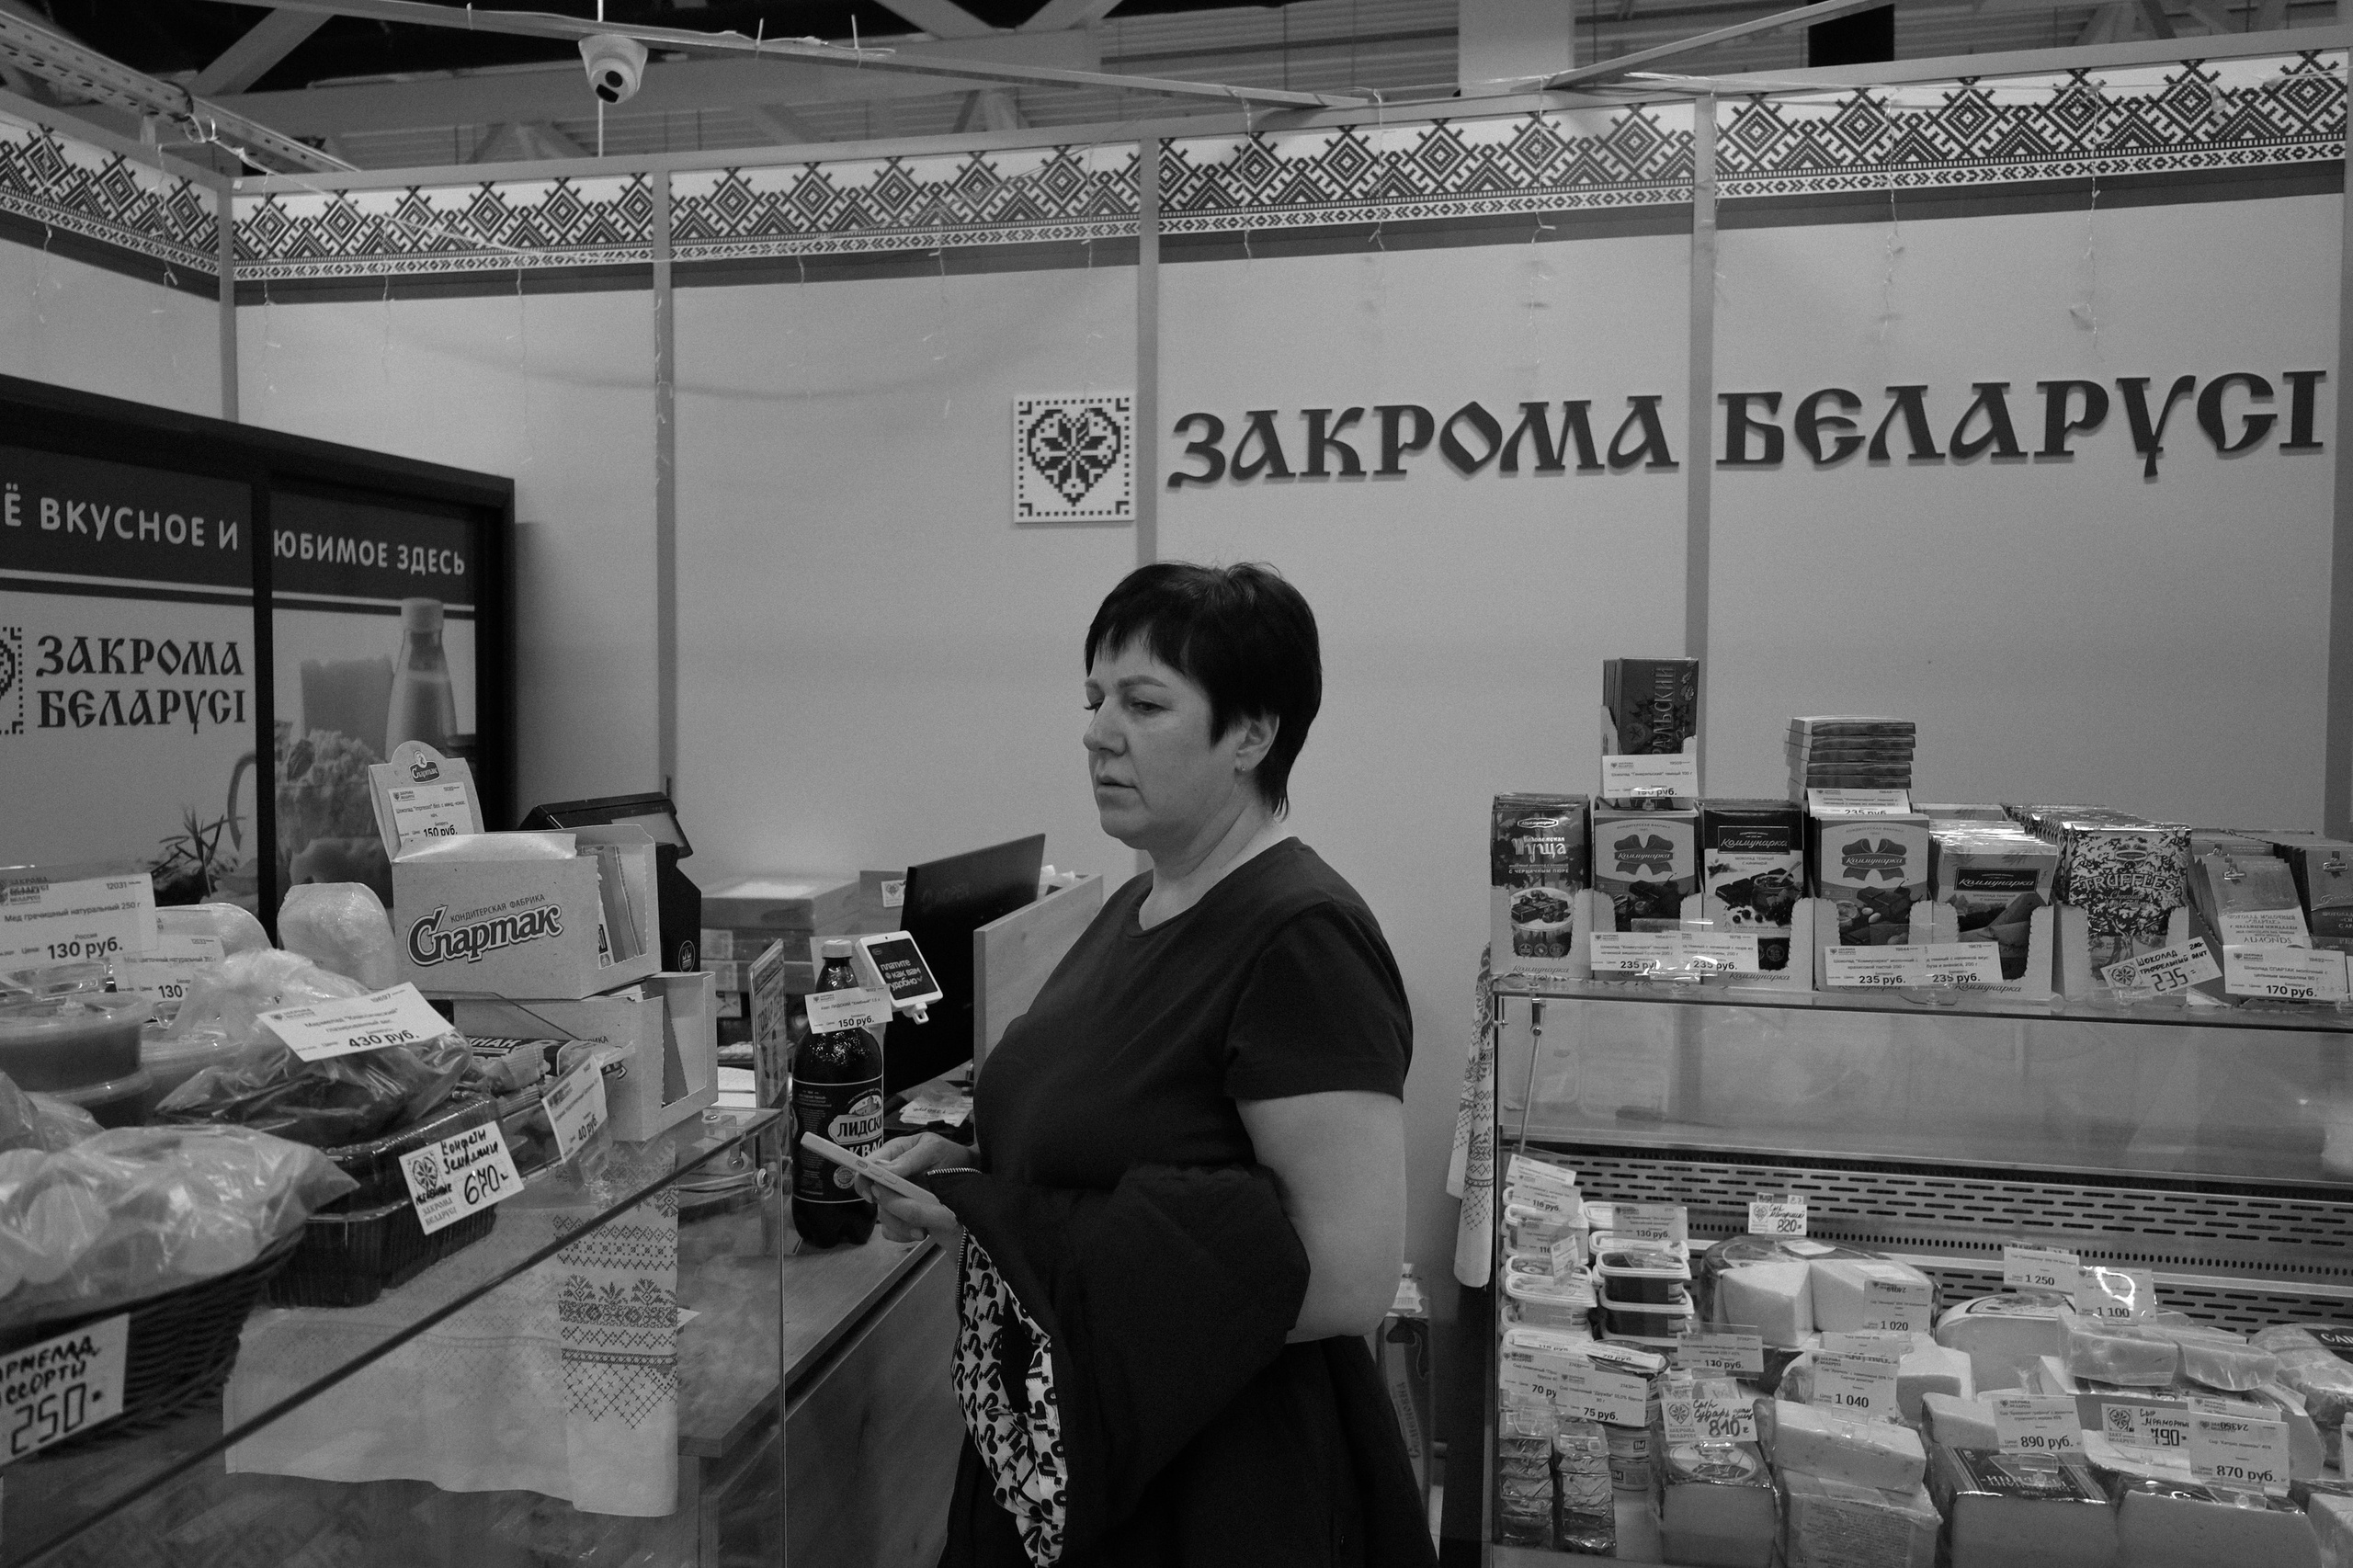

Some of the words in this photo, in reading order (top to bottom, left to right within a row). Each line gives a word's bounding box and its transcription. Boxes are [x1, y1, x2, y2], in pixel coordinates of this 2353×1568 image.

[1167, 394, 1680, 488] ЗАКРОМА
[40, 497, 205, 547] ВКУСНОЕ
[219, 520, 239, 551] И
[274, 529, 388, 568] ЮБИМОЕ
[397, 544, 465, 576] ЗДЕСЬ
[36, 634, 245, 678] ЗАКРОМА
[2079, 872, 2178, 892] TRUFFLES
[70, 903, 120, 916] натуральный
[120, 901, 136, 910] 250
[449, 902, 507, 924] КОНДИТЕРСКАЯ
[508, 893, 546, 909] ФАБРИКА
[407, 903, 563, 965] Спартак
[47, 941, 81, 960] 130
[85, 936, 124, 960] руб.
[880, 959, 912, 971] платите
[1620, 960, 1640, 969] 235
[2135, 949, 2178, 967] ШОКОЛАД
[891, 971, 905, 980] как
[905, 967, 922, 975] вам
[1716, 961, 1738, 971] руб.
[889, 977, 918, 992] удобно
[1859, 975, 1881, 984] 235
[1883, 975, 1906, 985] руб.
[1932, 973, 1954, 983] 235
[1957, 973, 1981, 983] руб.
[158, 984, 183, 999] 130
[2266, 984, 2288, 995] 170
[2290, 986, 2317, 998] руб.
[838, 1017, 855, 1028] 150
[856, 1015, 875, 1026] руб.
[348, 1035, 382, 1049] 430
[384, 1029, 420, 1044] руб.
[1545, 1204, 1561, 1212] руб.
[1889, 1321, 1909, 1332] 020
[1723, 1360, 1744, 1369] руб.
[1531, 1383, 1544, 1394] 70
[1545, 1387, 1557, 1398] ру
[1846, 1394, 1870, 1408] 040
[1583, 1407, 1596, 1417] 75
[1597, 1410, 1619, 1421] руб.
[2143, 1417, 2190, 1428] МРАМОРНЫ
[2019, 1436, 2044, 1448] 890
[2048, 1435, 2075, 1450] руб.
[2216, 1464, 2244, 1479] 870
[2247, 1471, 2277, 1484] руб.
